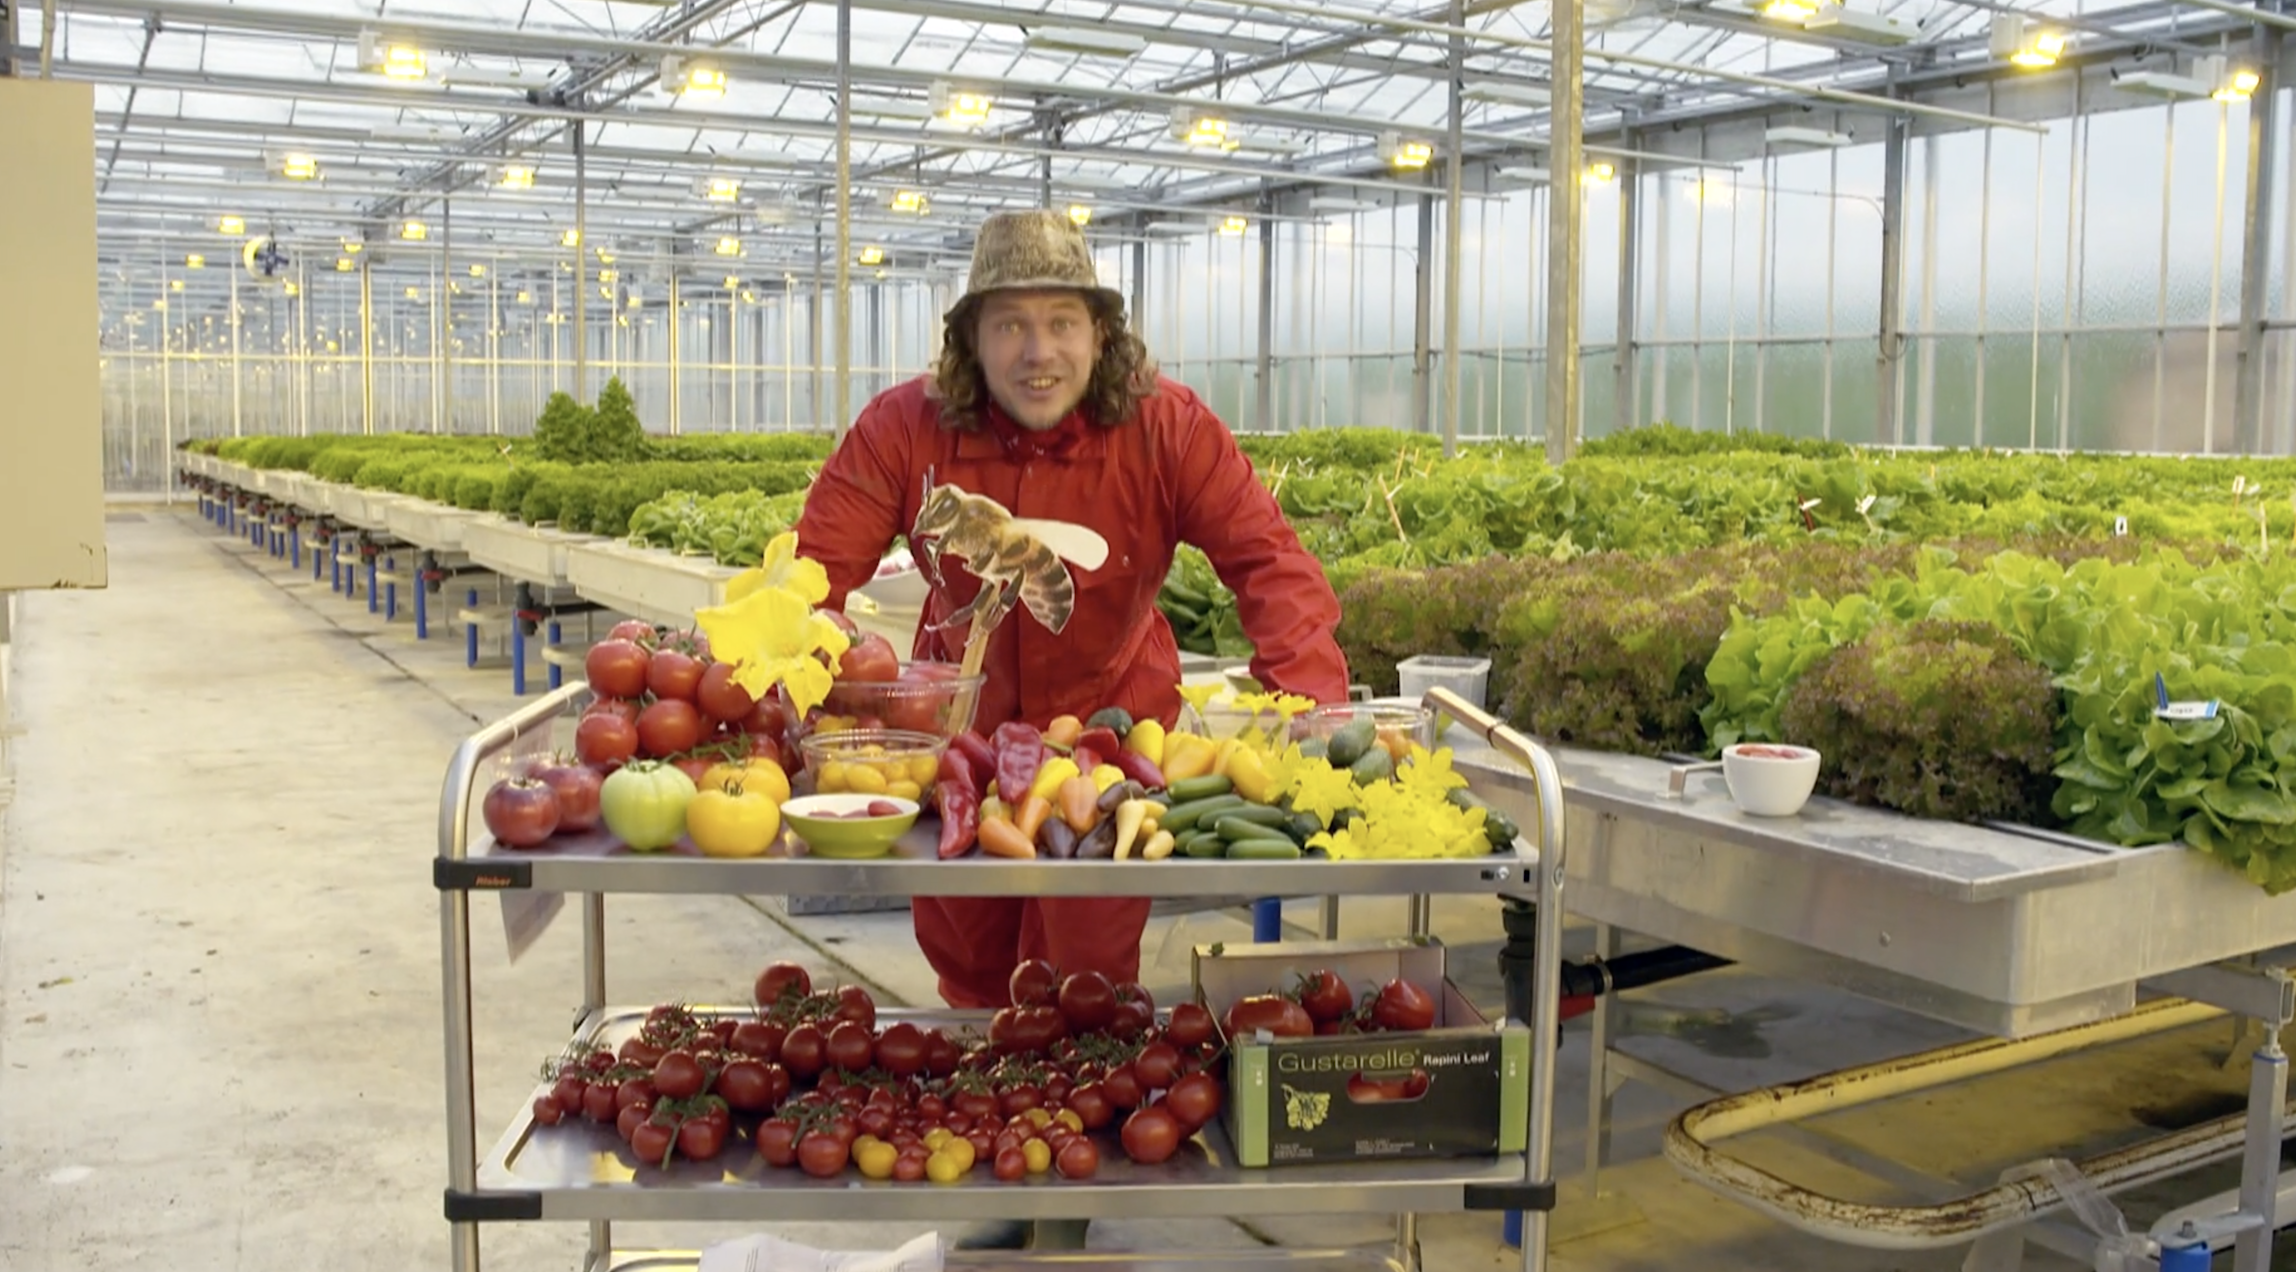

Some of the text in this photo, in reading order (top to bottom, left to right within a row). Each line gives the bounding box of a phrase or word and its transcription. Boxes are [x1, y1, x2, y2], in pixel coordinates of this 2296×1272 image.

[1278, 1049, 1490, 1072] Gustarelle Rapini Leaf
